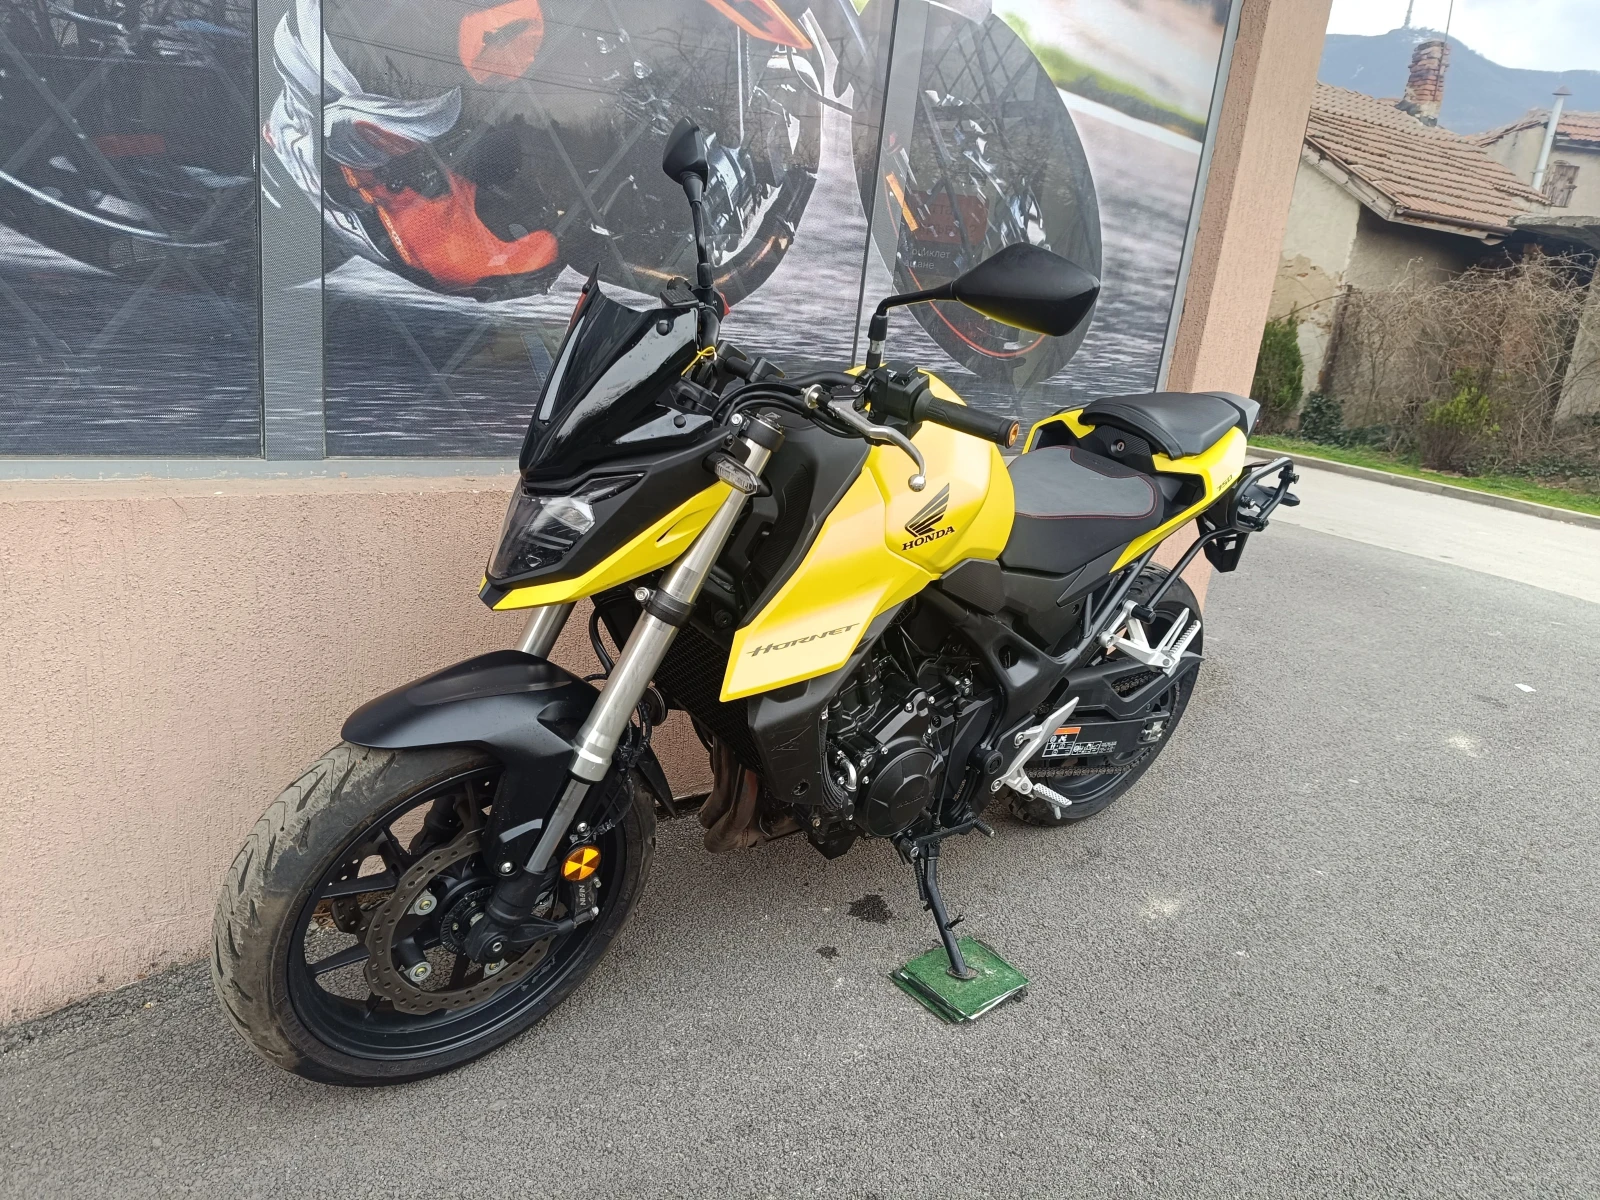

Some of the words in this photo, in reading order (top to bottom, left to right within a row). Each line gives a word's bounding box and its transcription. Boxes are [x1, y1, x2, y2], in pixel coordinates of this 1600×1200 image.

[912, 248, 951, 259] оциклет
[902, 526, 955, 551] HONDA
[746, 622, 860, 657] HORNET
